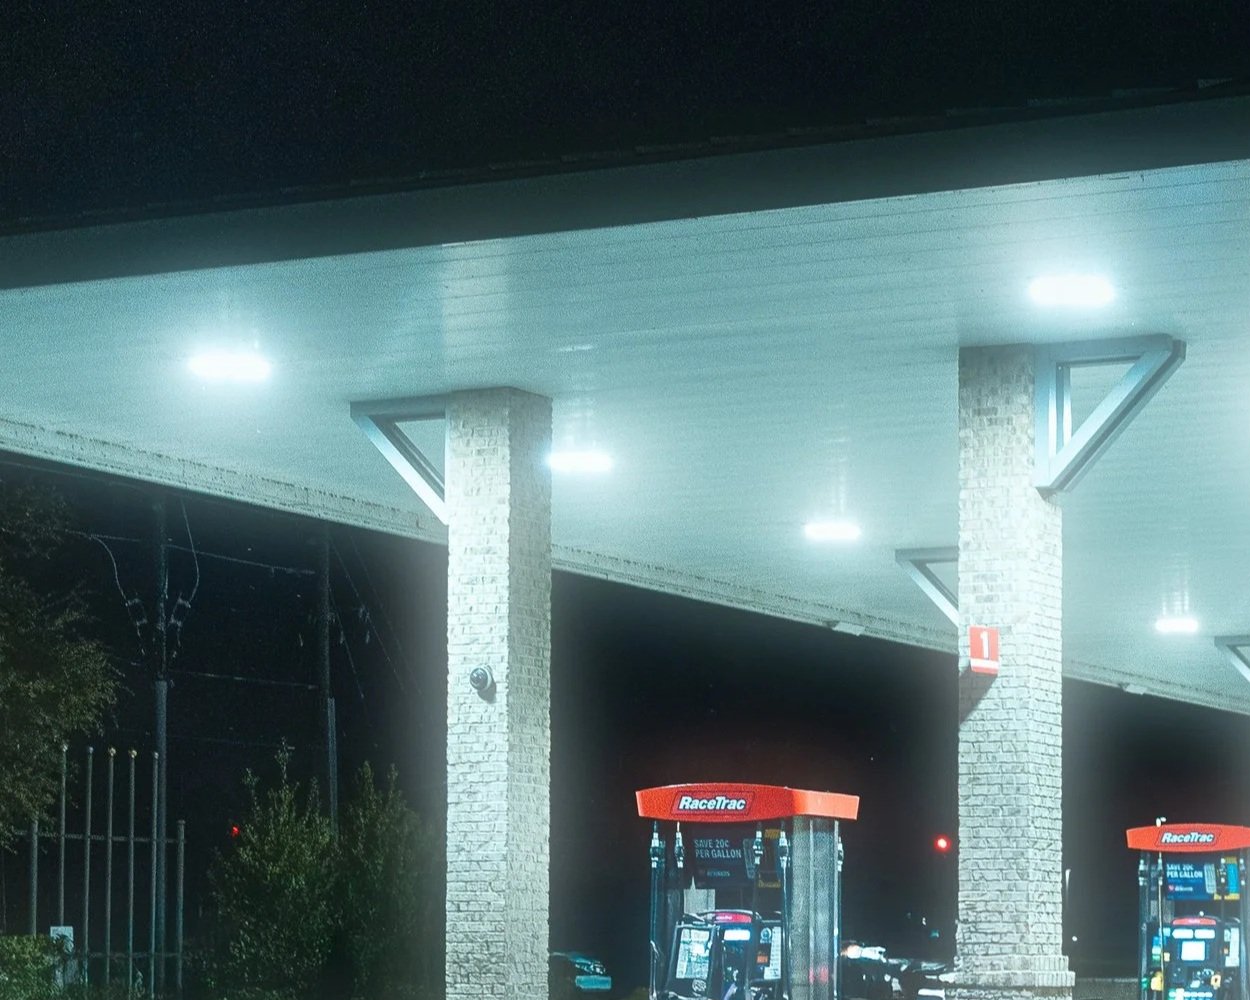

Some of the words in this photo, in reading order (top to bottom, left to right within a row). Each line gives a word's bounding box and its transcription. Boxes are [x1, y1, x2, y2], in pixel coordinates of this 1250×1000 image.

[979, 630, 989, 659] 1
[679, 796, 746, 810] RaceTrac
[1162, 832, 1214, 843] RaceTrac
[694, 839, 713, 848] SAVE
[695, 849, 710, 858] PER
[711, 848, 742, 858] GALLON
